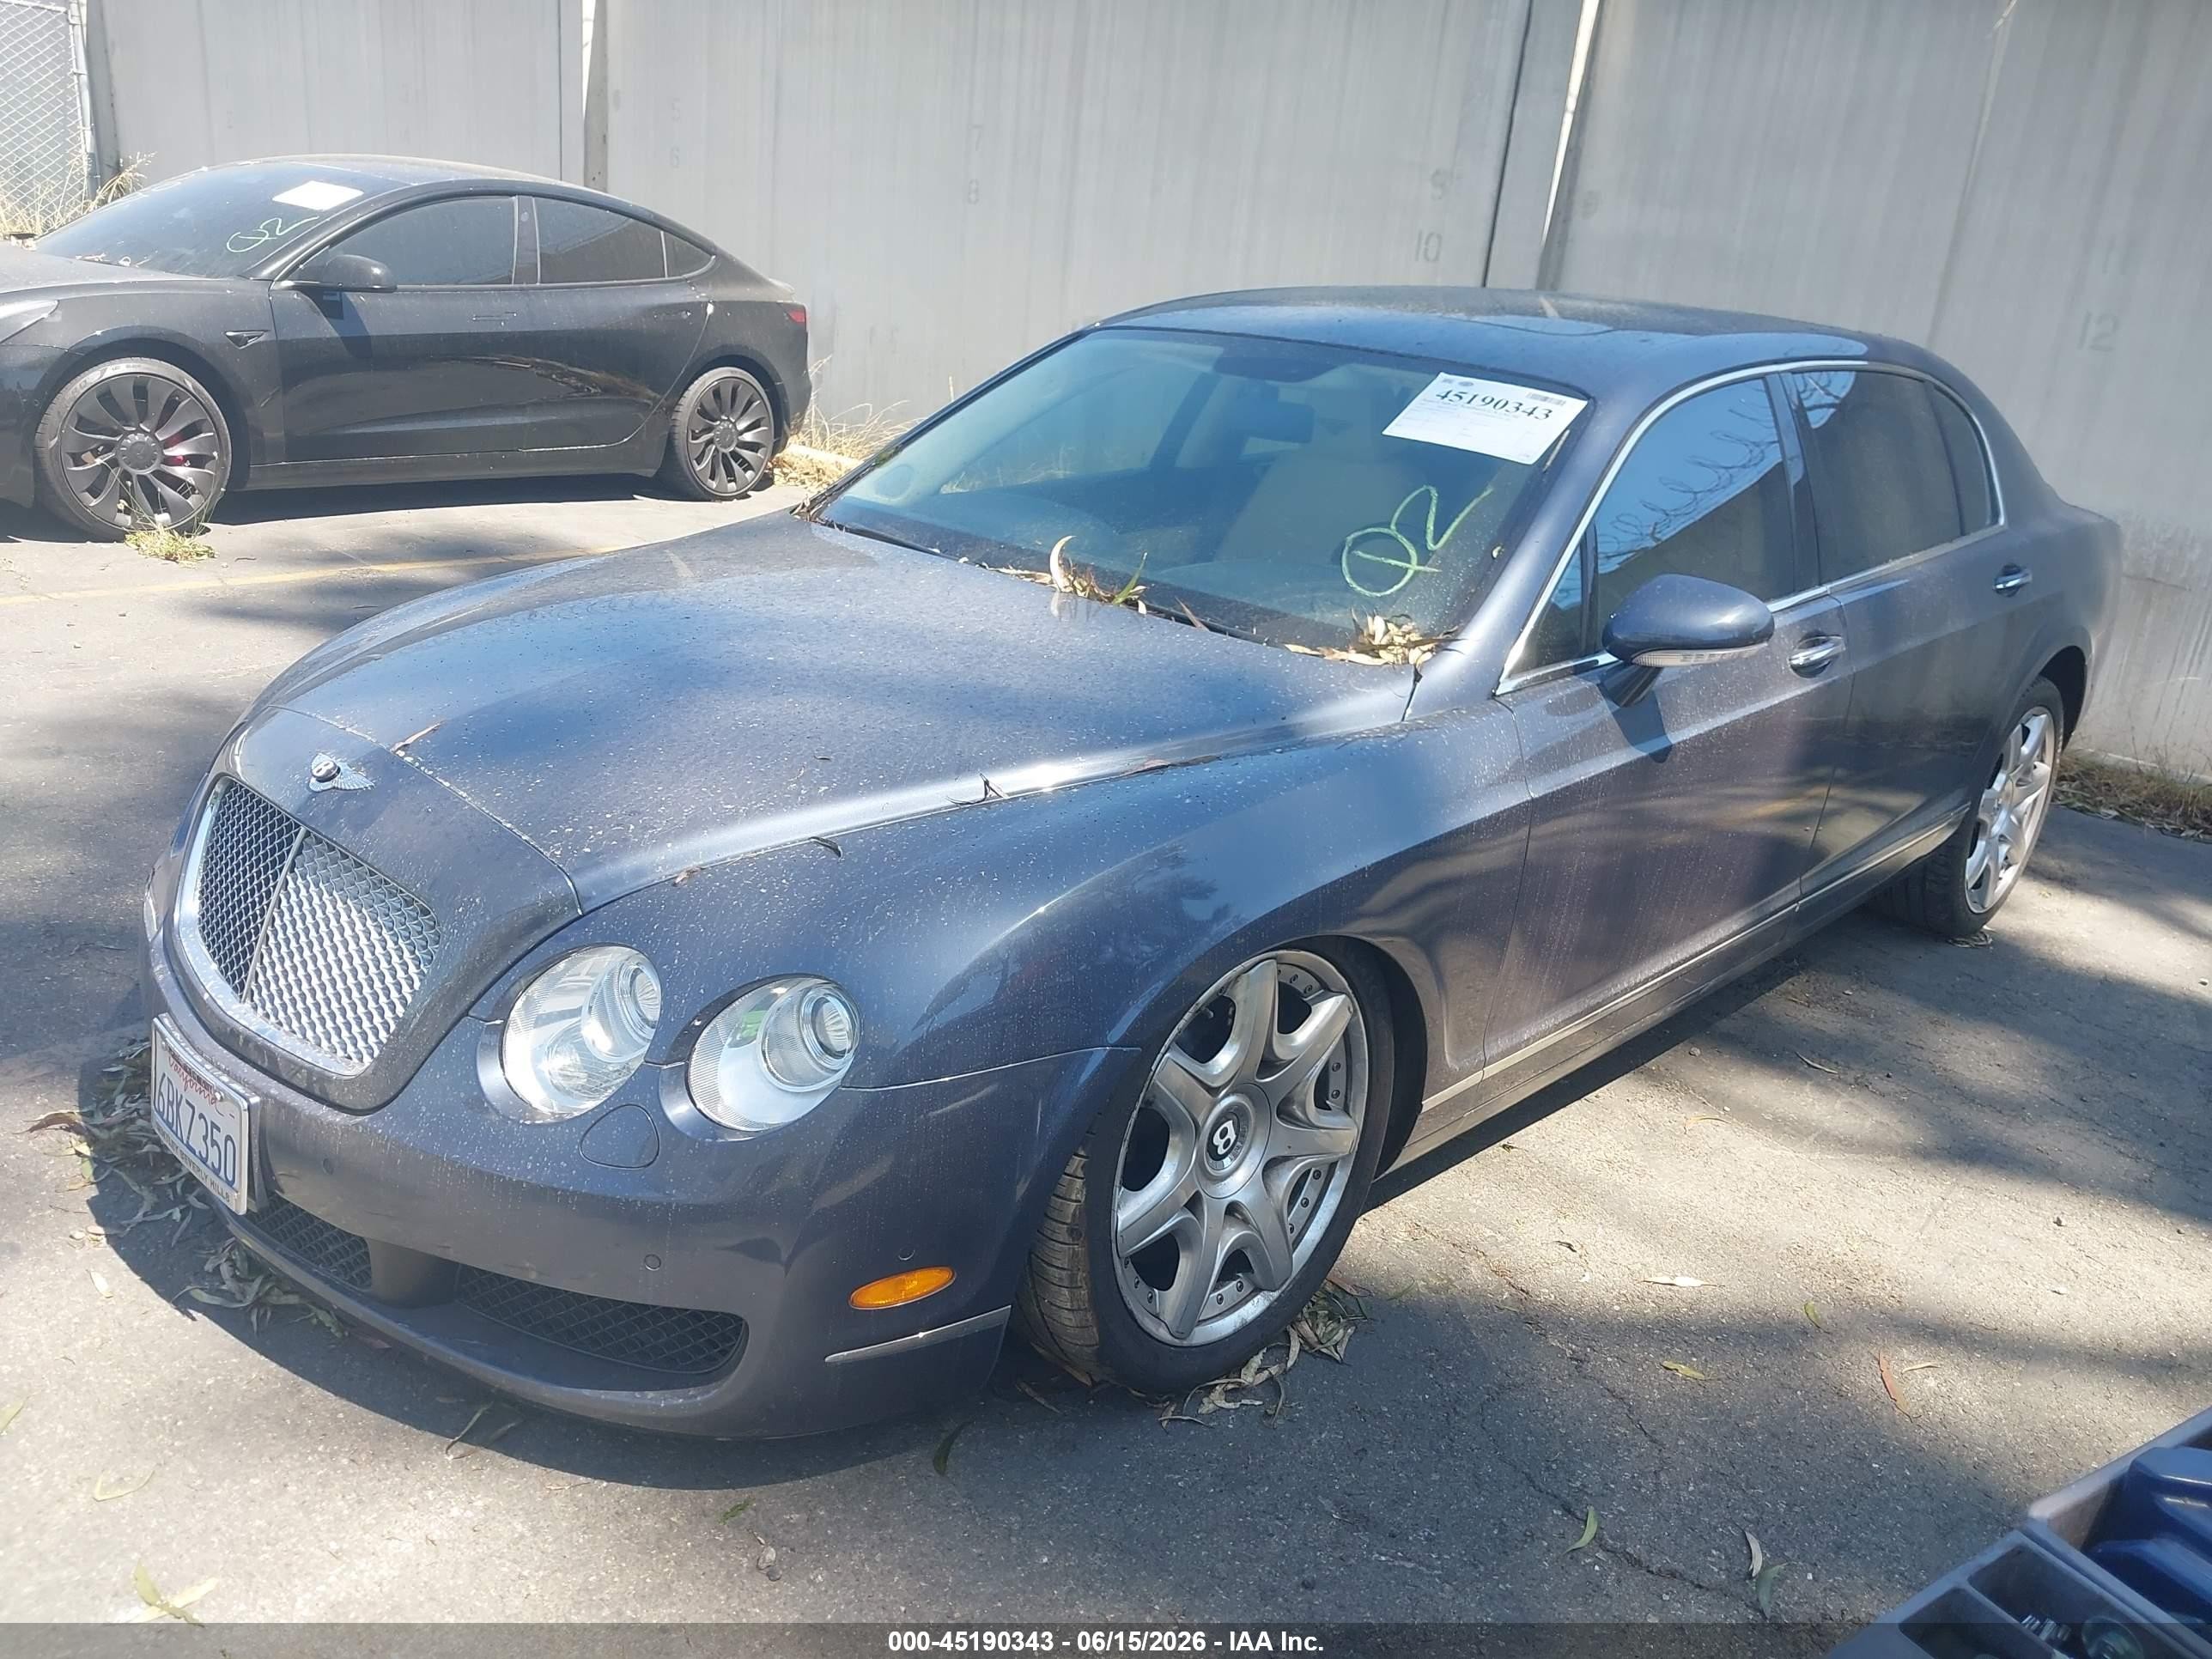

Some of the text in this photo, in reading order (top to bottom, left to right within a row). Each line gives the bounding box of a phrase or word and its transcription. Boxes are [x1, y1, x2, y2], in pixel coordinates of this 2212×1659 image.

[1414, 229, 1443, 263] 10
[2076, 309, 2121, 353] 12
[1435, 388, 1553, 421] 45190343
[156, 1072, 236, 1187] 6BKZ350
[179, 1149, 209, 1183] BEVERLY
[210, 1180, 230, 1203] HILLS
